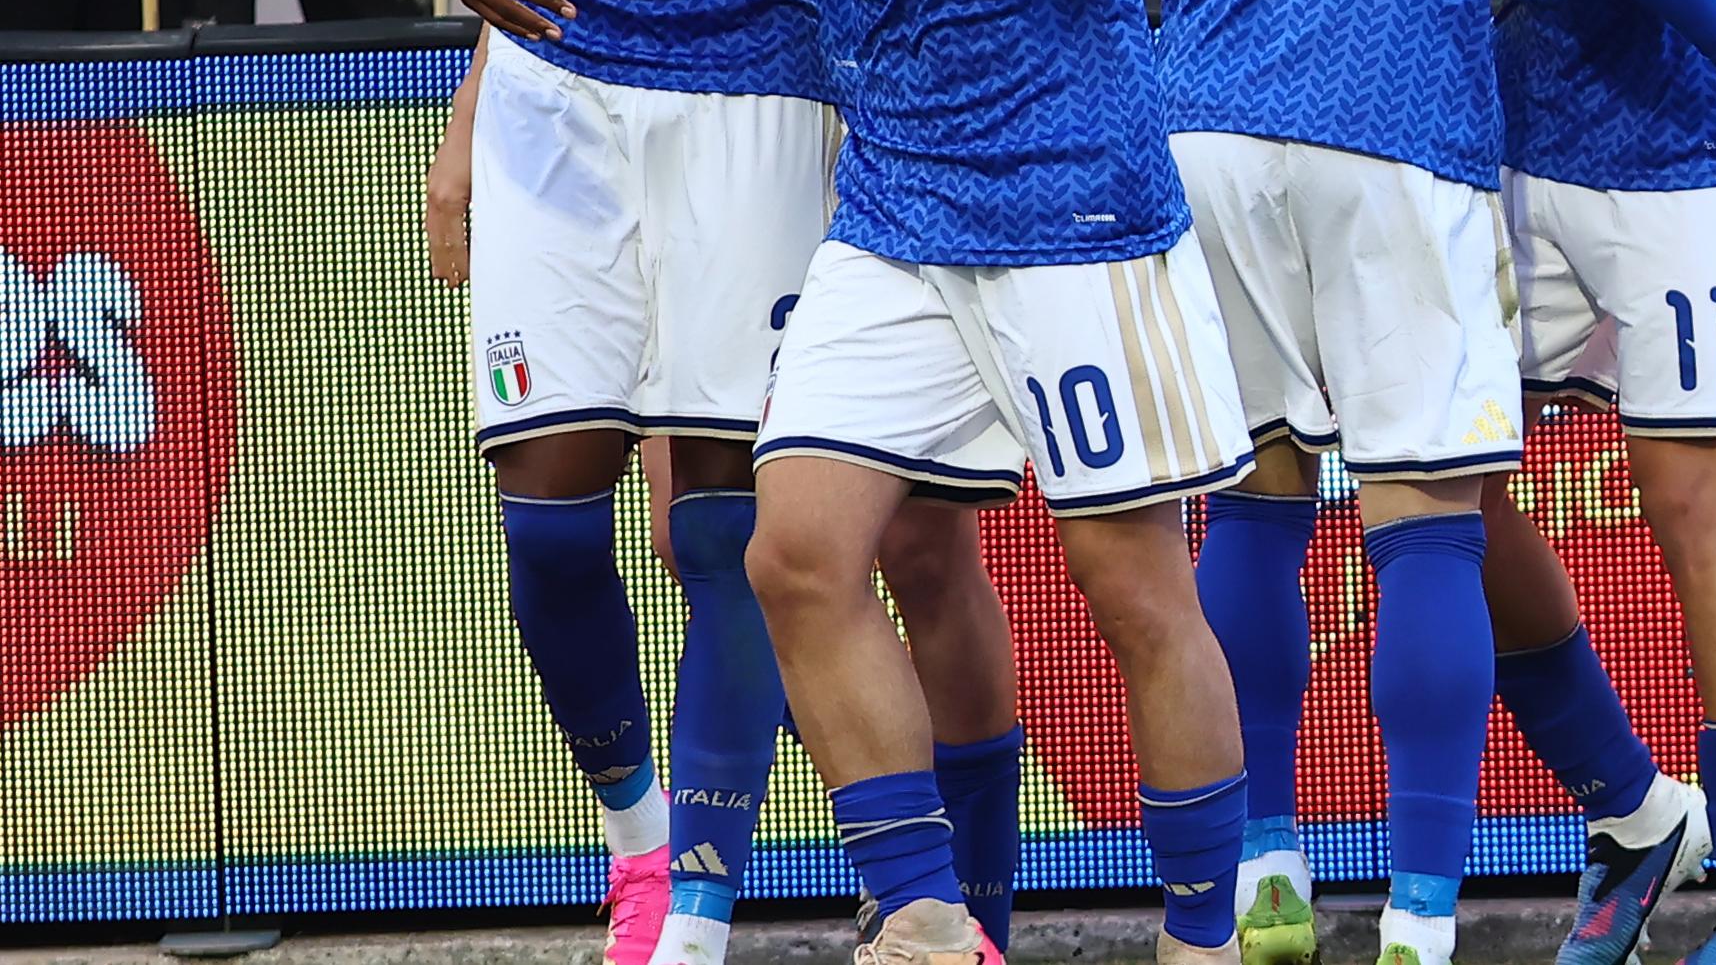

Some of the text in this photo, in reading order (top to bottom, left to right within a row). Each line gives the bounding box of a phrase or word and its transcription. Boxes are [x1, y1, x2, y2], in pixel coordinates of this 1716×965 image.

[489, 346, 521, 363] ITALIA
[1026, 364, 1125, 478] 10
[674, 788, 752, 811] ITALIA
